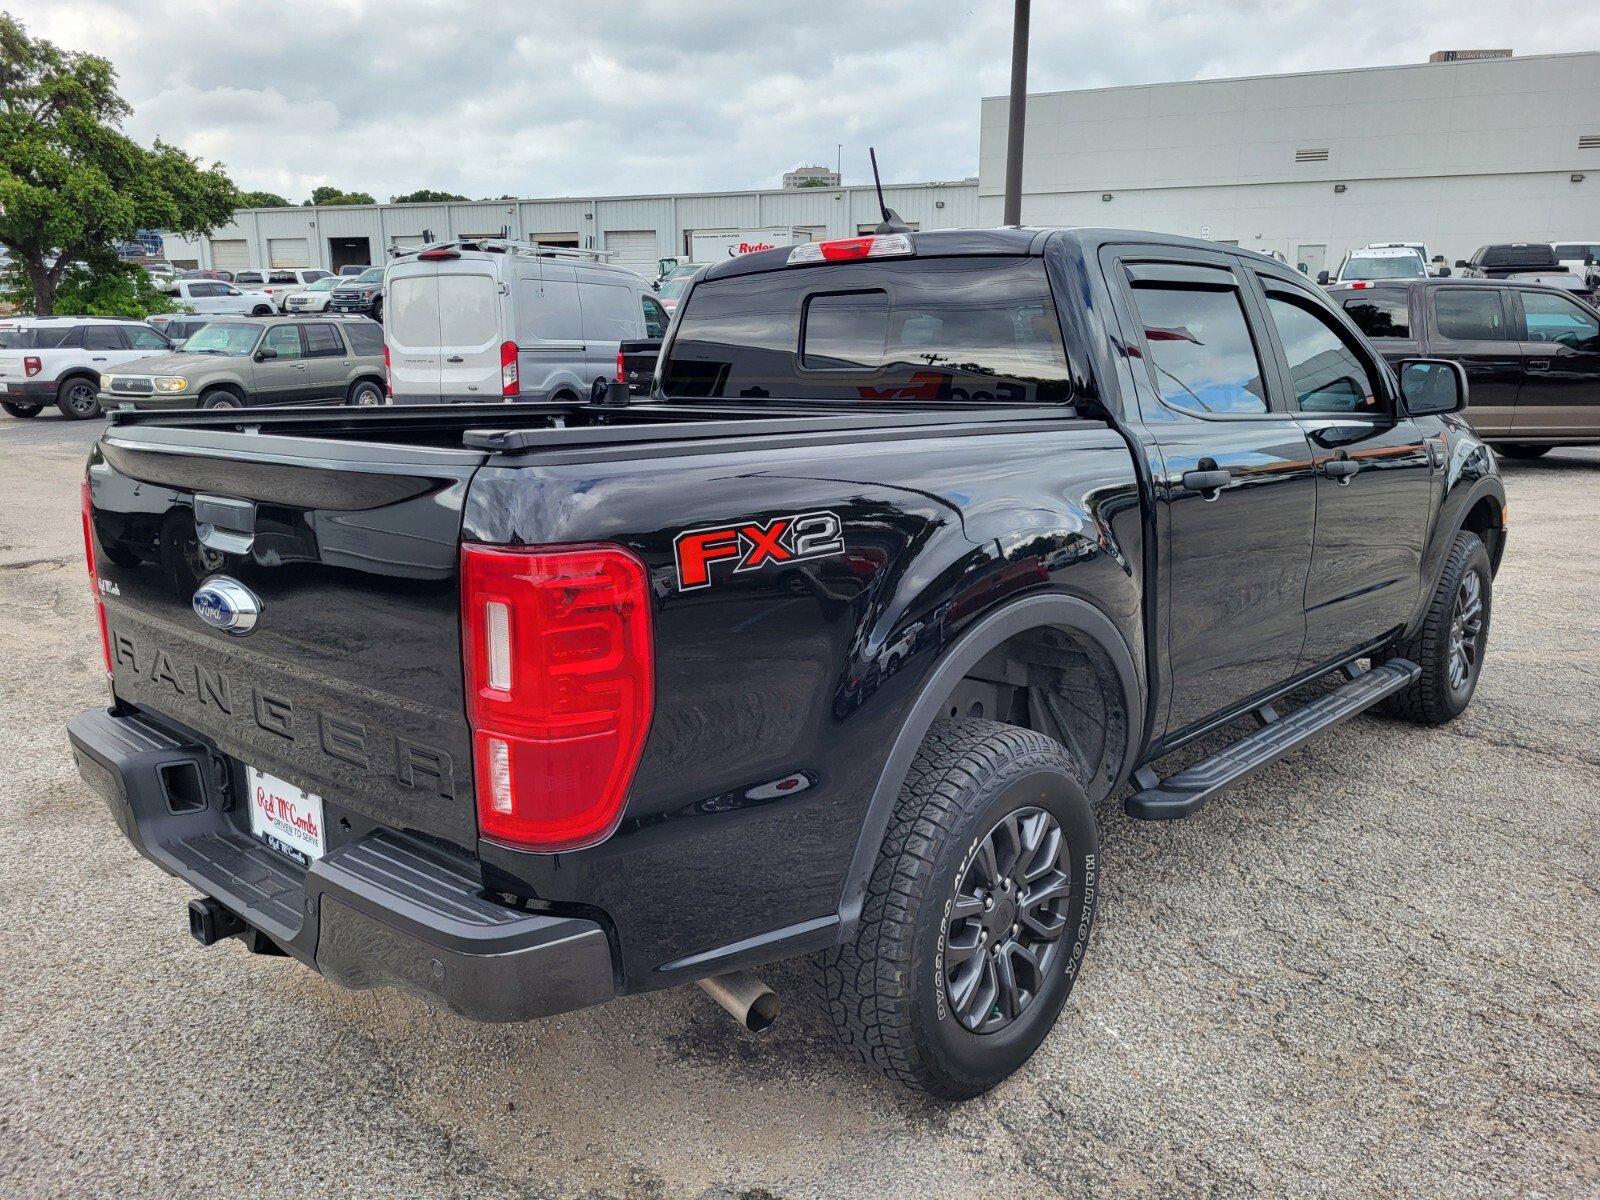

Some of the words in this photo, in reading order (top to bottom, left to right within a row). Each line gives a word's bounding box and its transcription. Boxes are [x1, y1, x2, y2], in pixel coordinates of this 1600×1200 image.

[672, 510, 846, 593] FX2
[199, 593, 222, 620] Ford
[112, 628, 456, 802] RANGER
[256, 786, 275, 821] Red
[274, 796, 318, 838] McCombs
[273, 817, 293, 833] DRIVEN
[294, 827, 302, 838] TO
[302, 831, 319, 847] SERVE
[268, 835, 280, 850] Red
